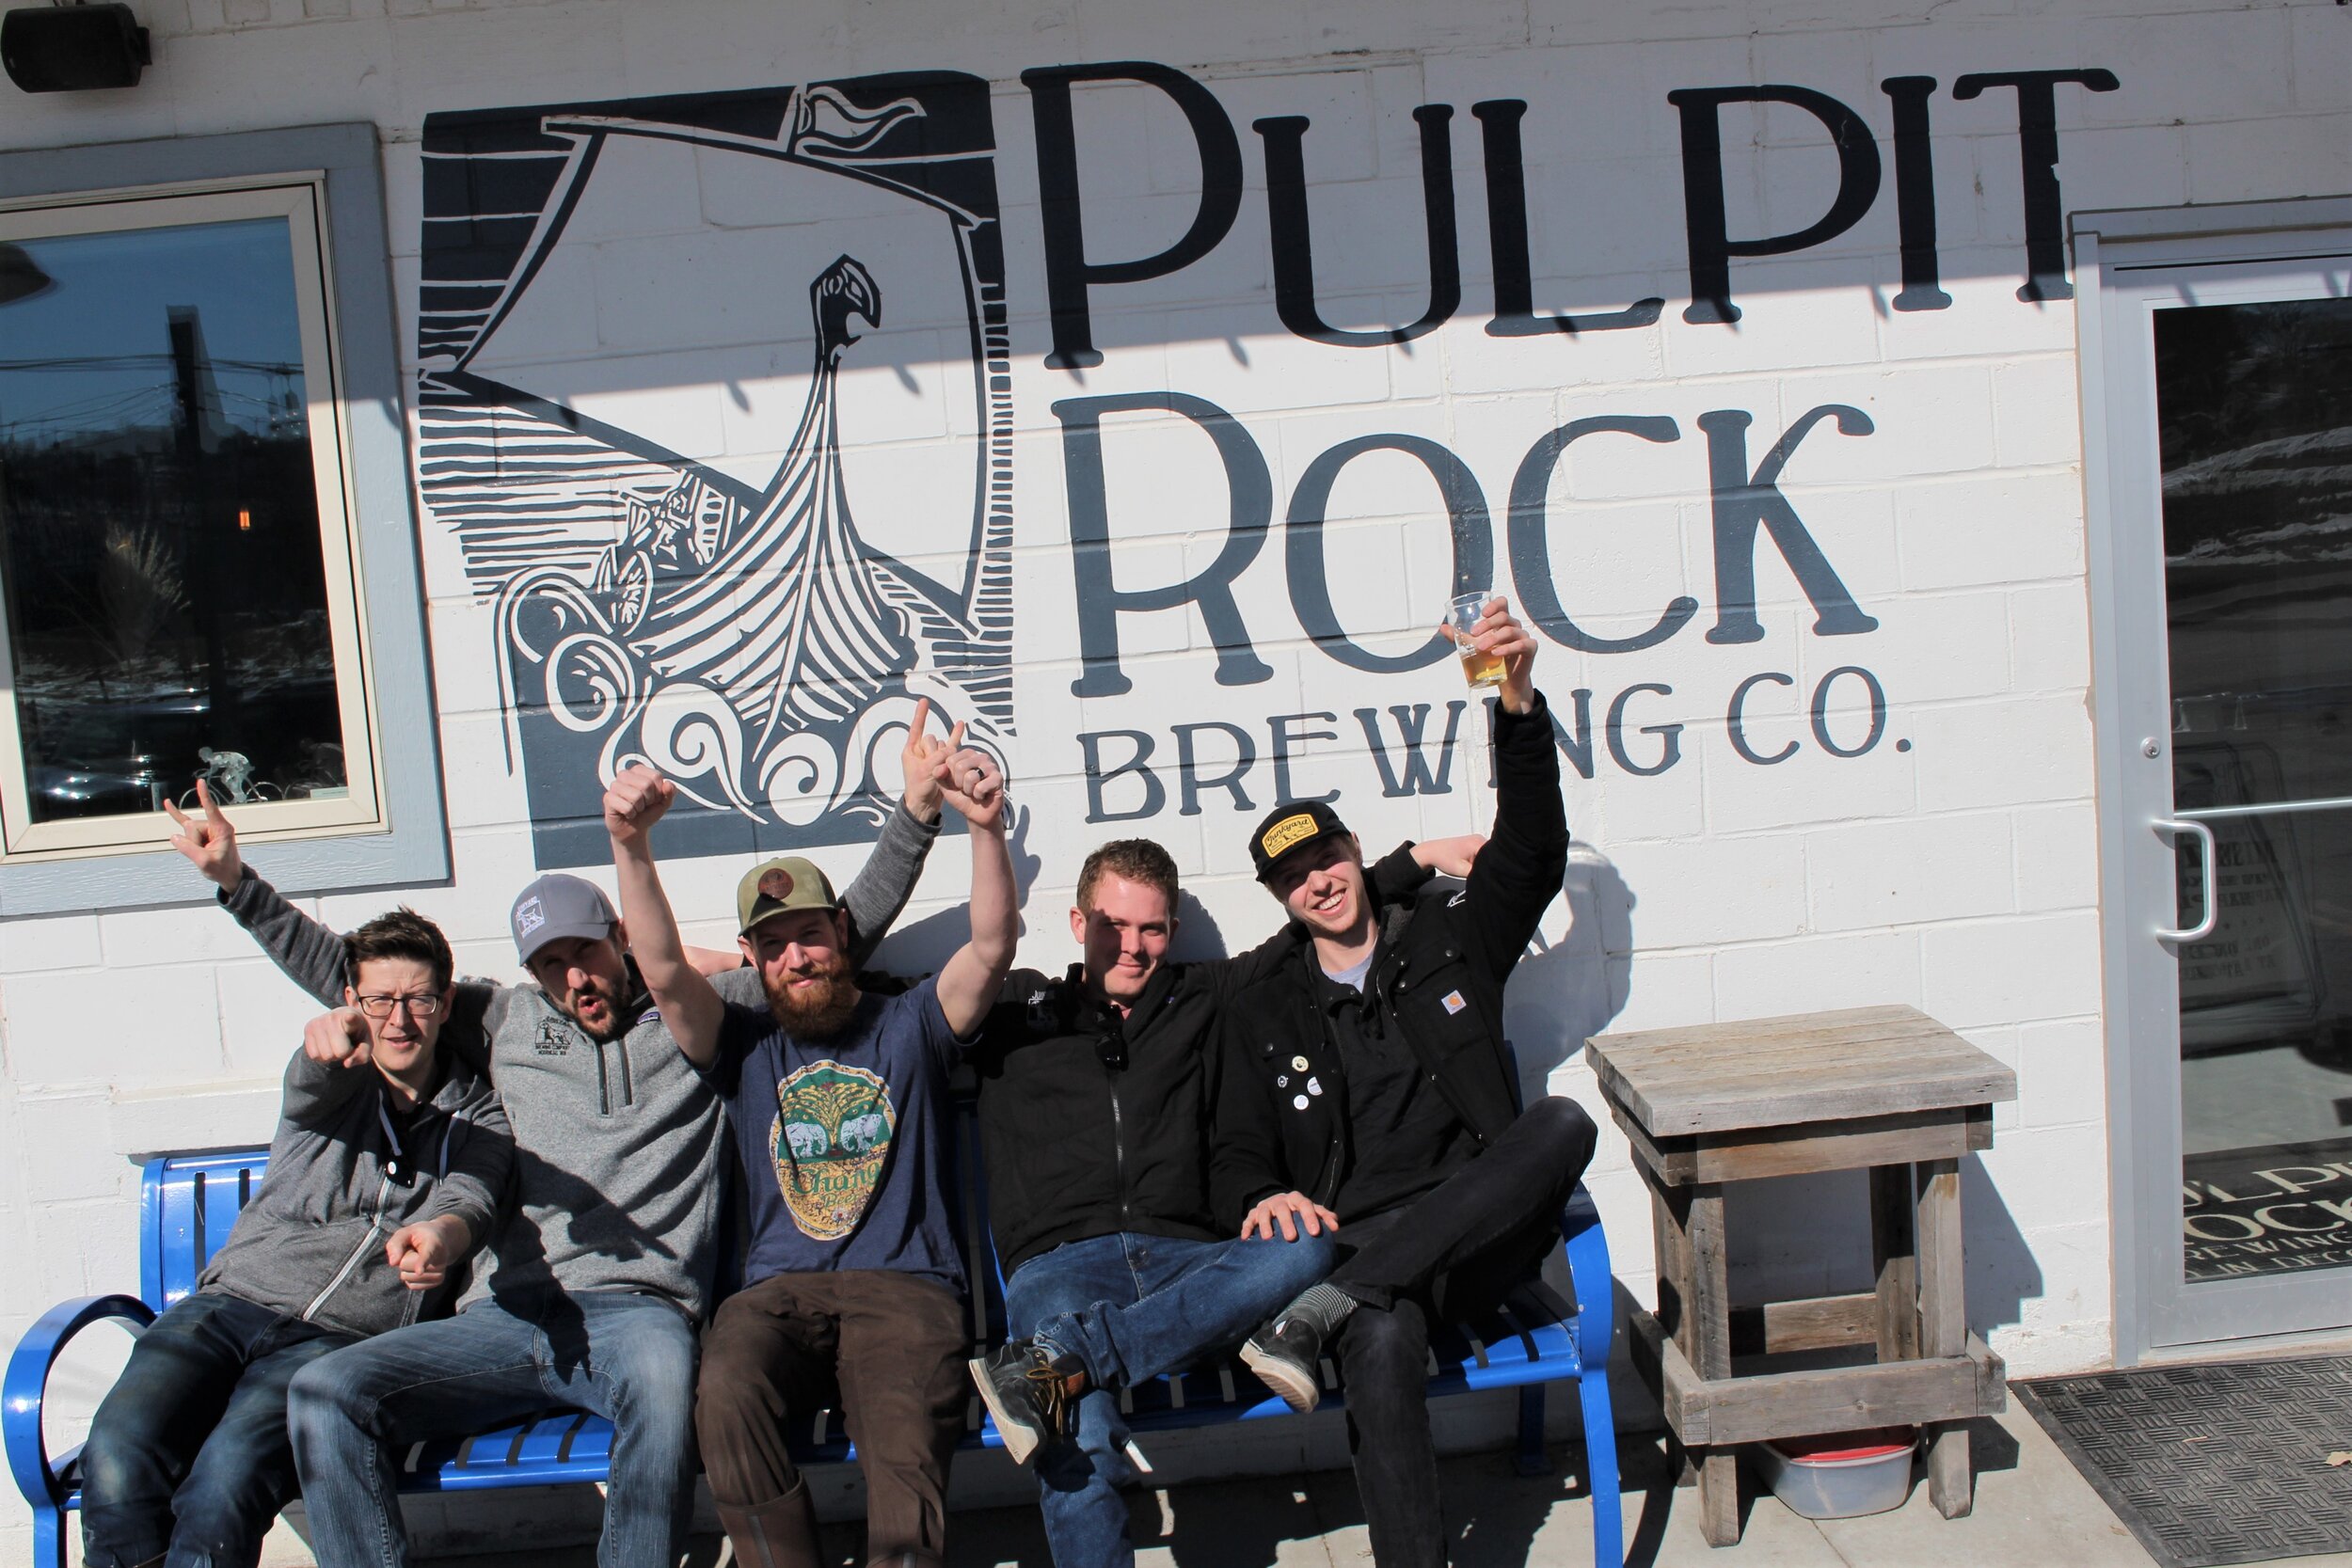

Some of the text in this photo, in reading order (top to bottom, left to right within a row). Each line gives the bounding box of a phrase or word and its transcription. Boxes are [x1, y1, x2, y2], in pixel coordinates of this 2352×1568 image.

[1021, 61, 2121, 370] PULPIT
[1050, 390, 1879, 699] ROCK
[1727, 665, 1913, 766] CO.
[1267, 818, 1310, 847] Junkyard
